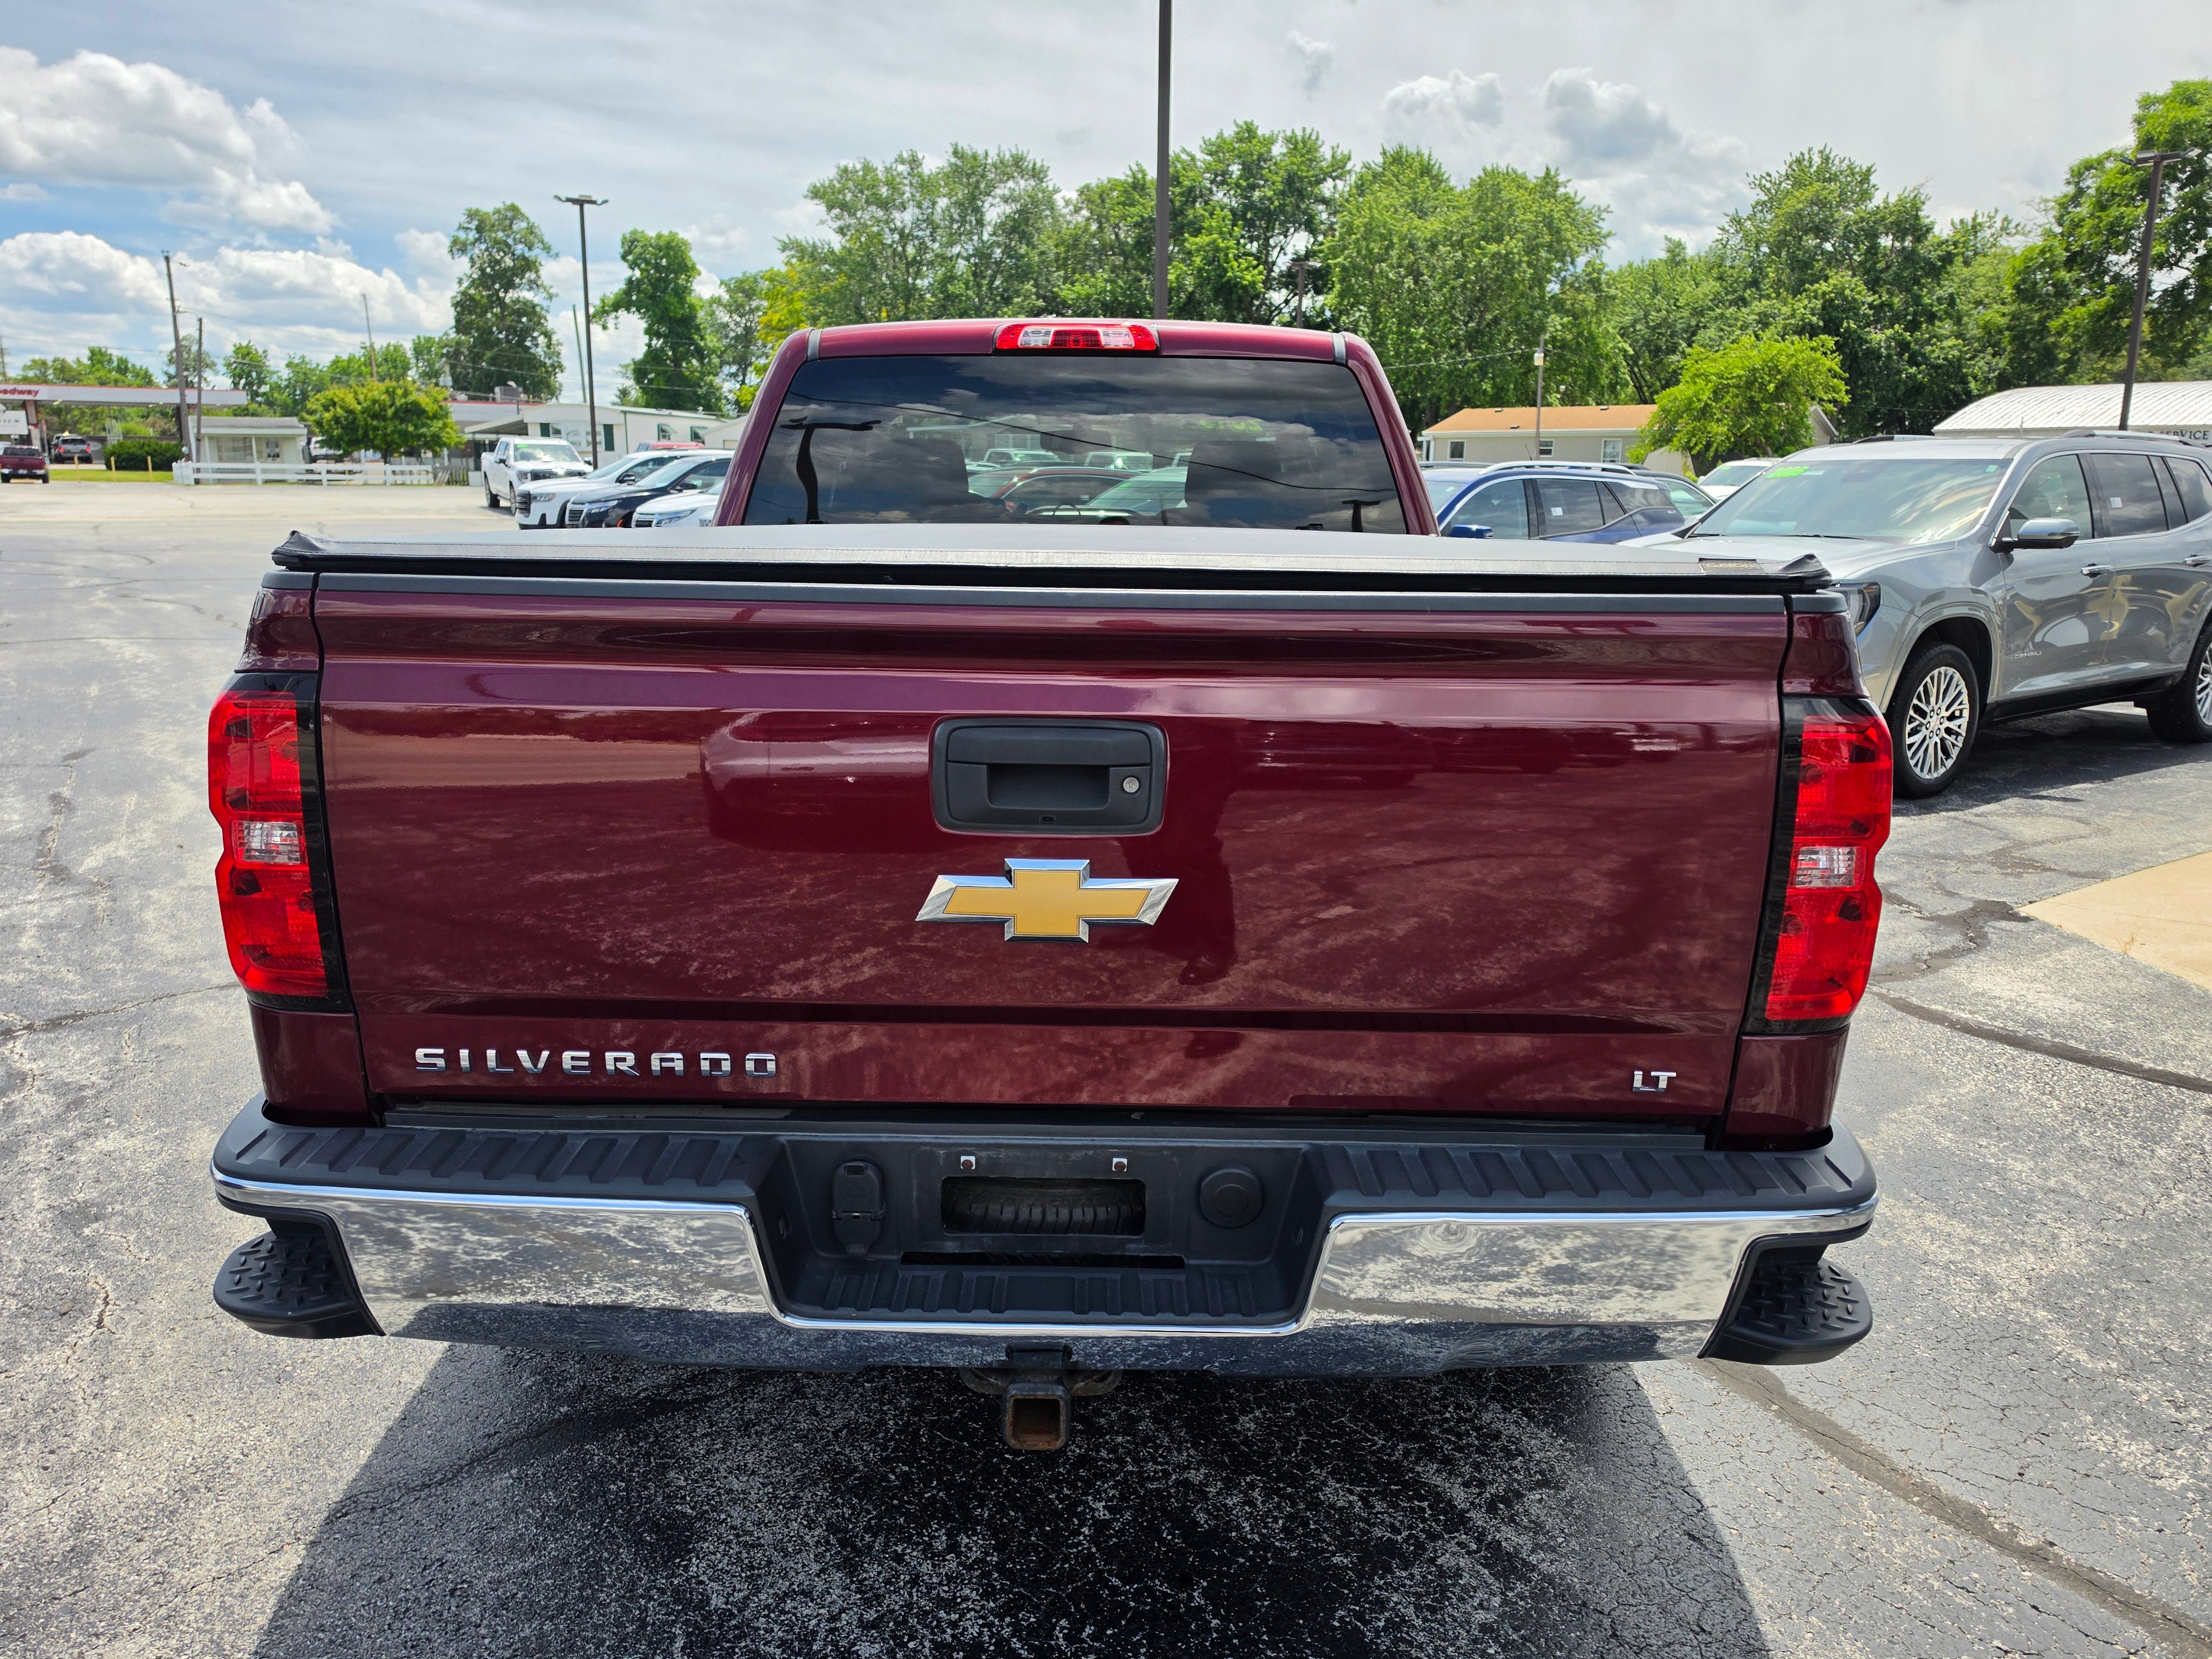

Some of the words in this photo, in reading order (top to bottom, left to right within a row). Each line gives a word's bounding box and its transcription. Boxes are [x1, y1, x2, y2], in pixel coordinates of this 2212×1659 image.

[0, 387, 39, 398] edway
[2159, 430, 2210, 440] RVICE
[2013, 650, 2042, 659] DENALI
[415, 1047, 777, 1078] SILVERADO
[1631, 1070, 1677, 1093] LT
